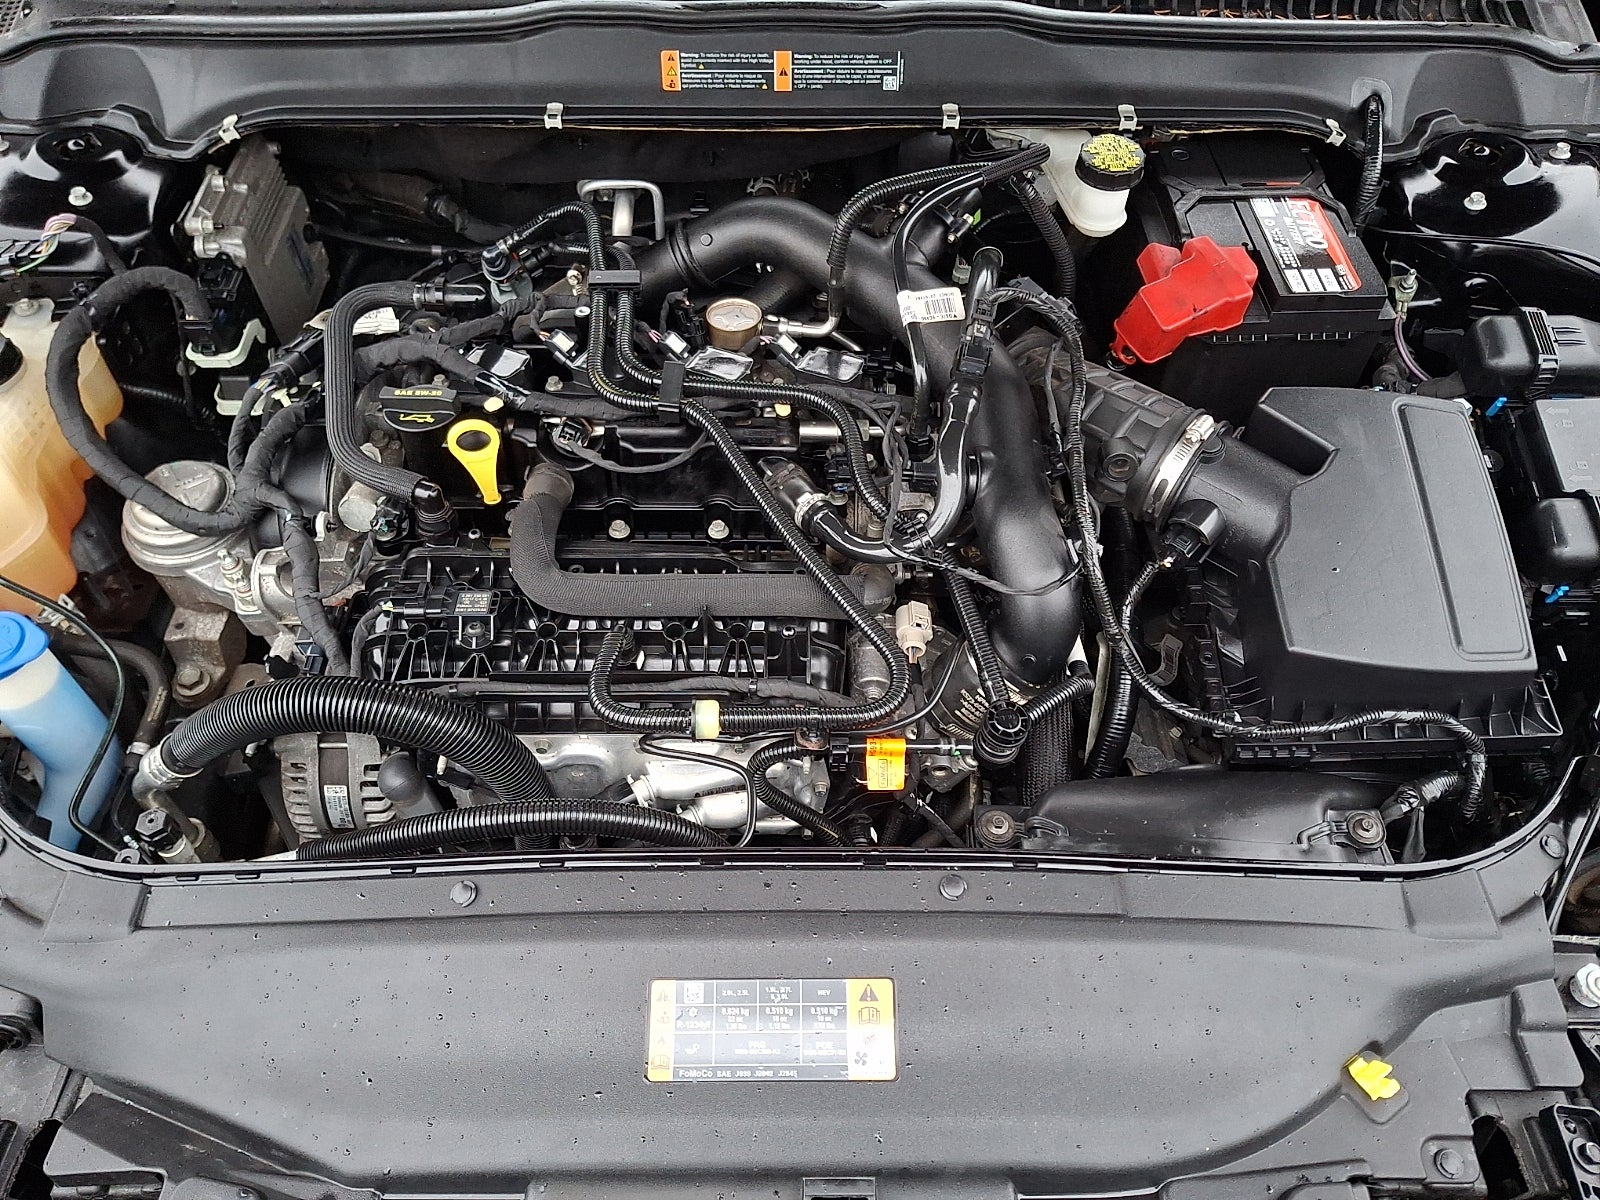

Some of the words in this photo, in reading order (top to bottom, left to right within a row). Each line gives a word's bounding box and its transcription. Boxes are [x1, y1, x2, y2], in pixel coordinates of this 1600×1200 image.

[1284, 198, 1329, 250] ECTRO
[741, 1008, 750, 1016] kg
[785, 1007, 793, 1016] kg
[830, 1007, 838, 1016] kg
